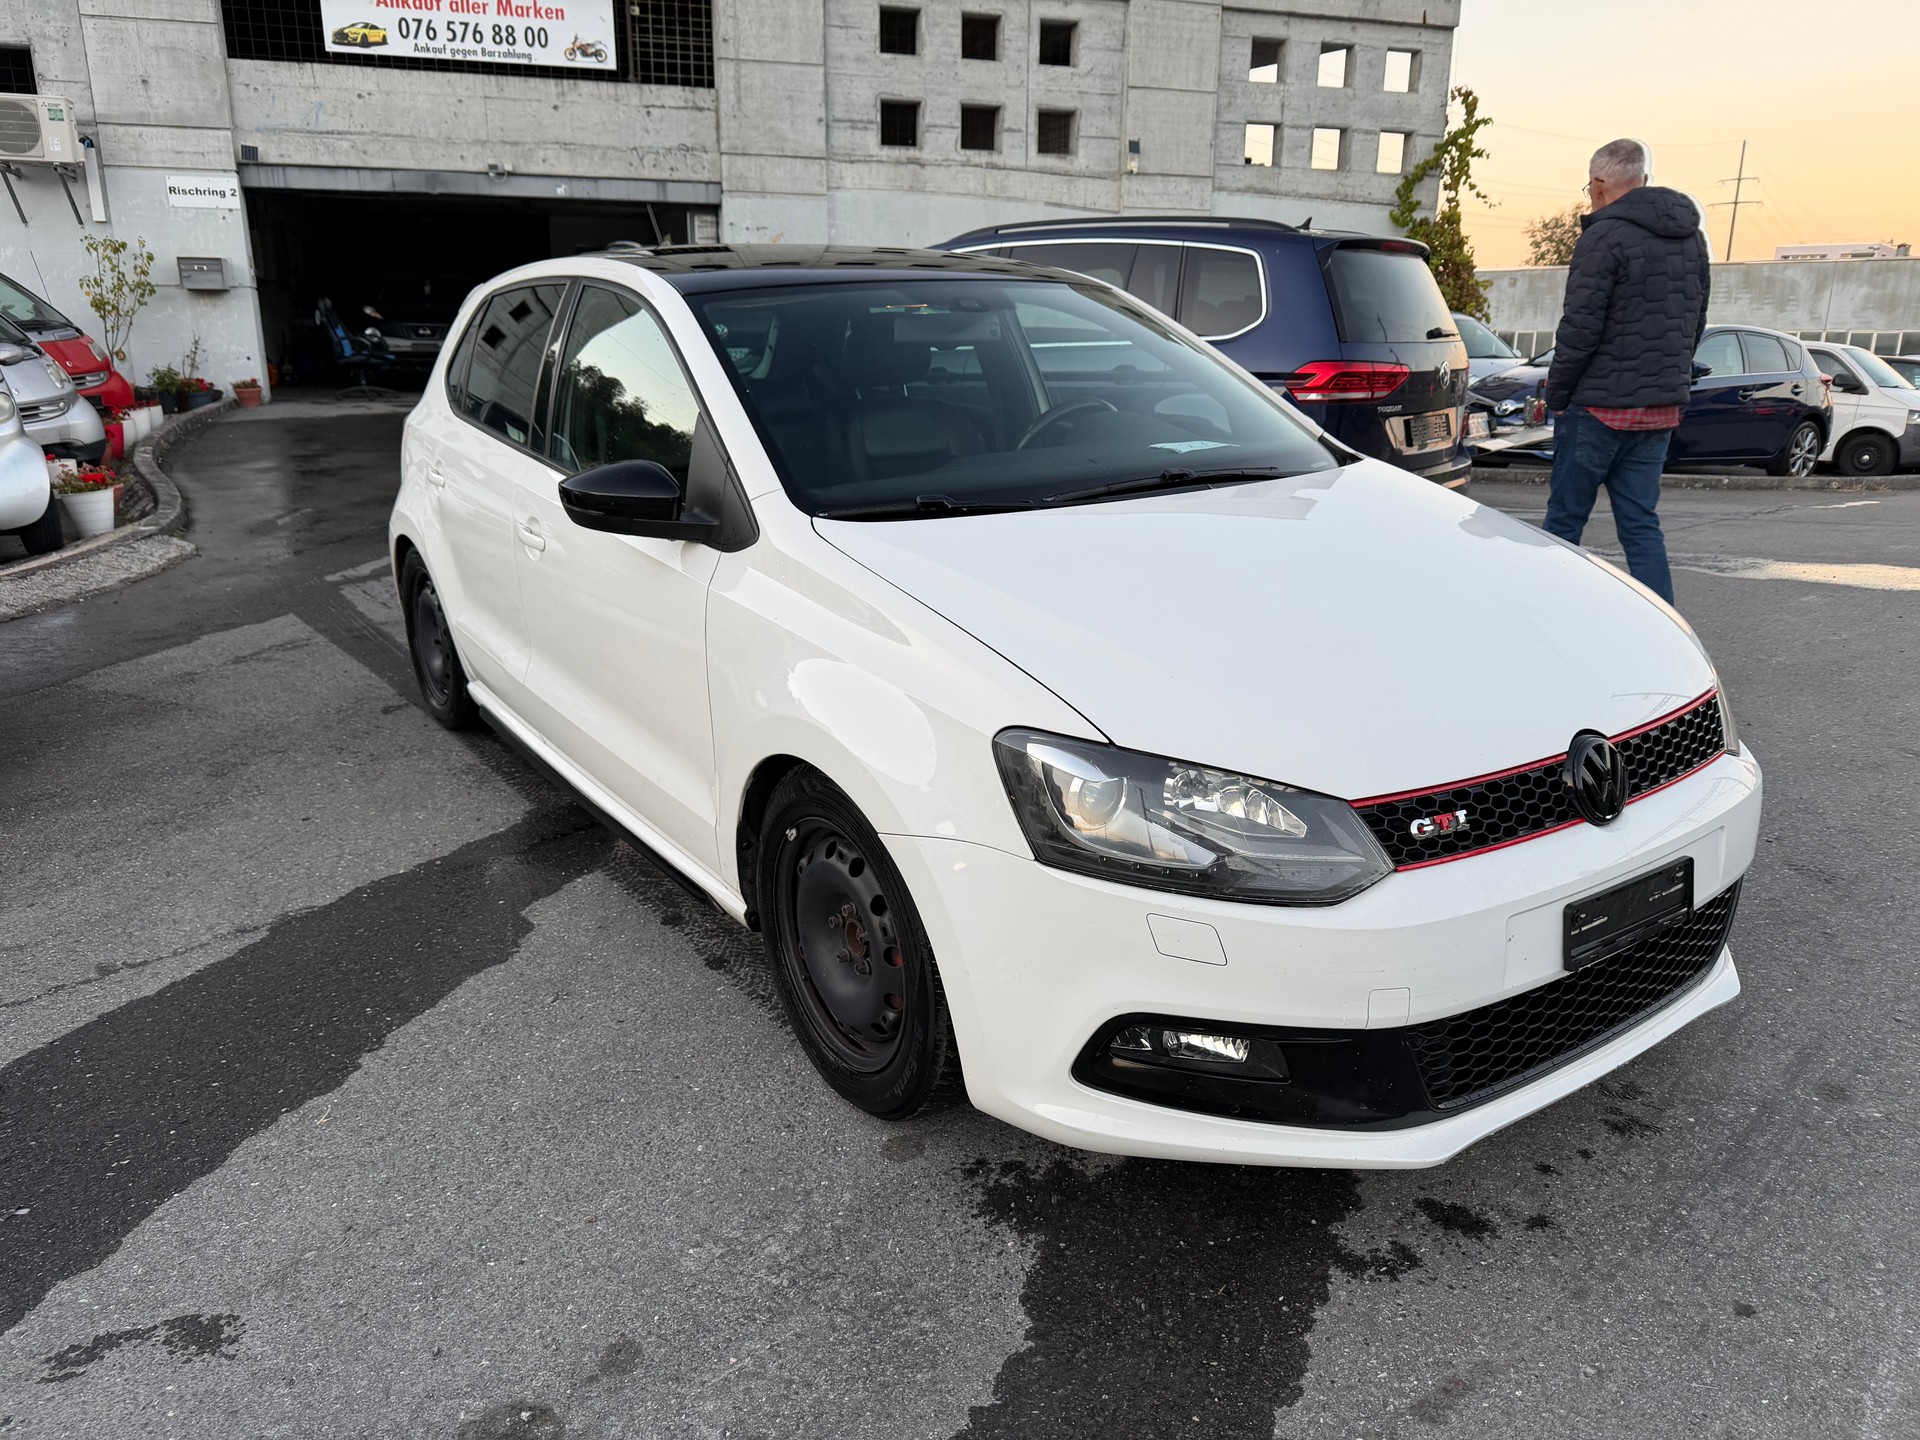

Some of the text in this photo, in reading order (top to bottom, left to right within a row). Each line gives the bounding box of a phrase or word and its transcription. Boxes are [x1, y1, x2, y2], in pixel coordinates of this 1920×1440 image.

[449, 0, 488, 15] aller
[496, 0, 565, 20] Marken
[398, 17, 549, 49] 076 576 88 00
[413, 42, 533, 62] Ankauf gegen Barzahlung
[168, 186, 237, 199] Rischring 2
[1409, 809, 1470, 840] GTI
